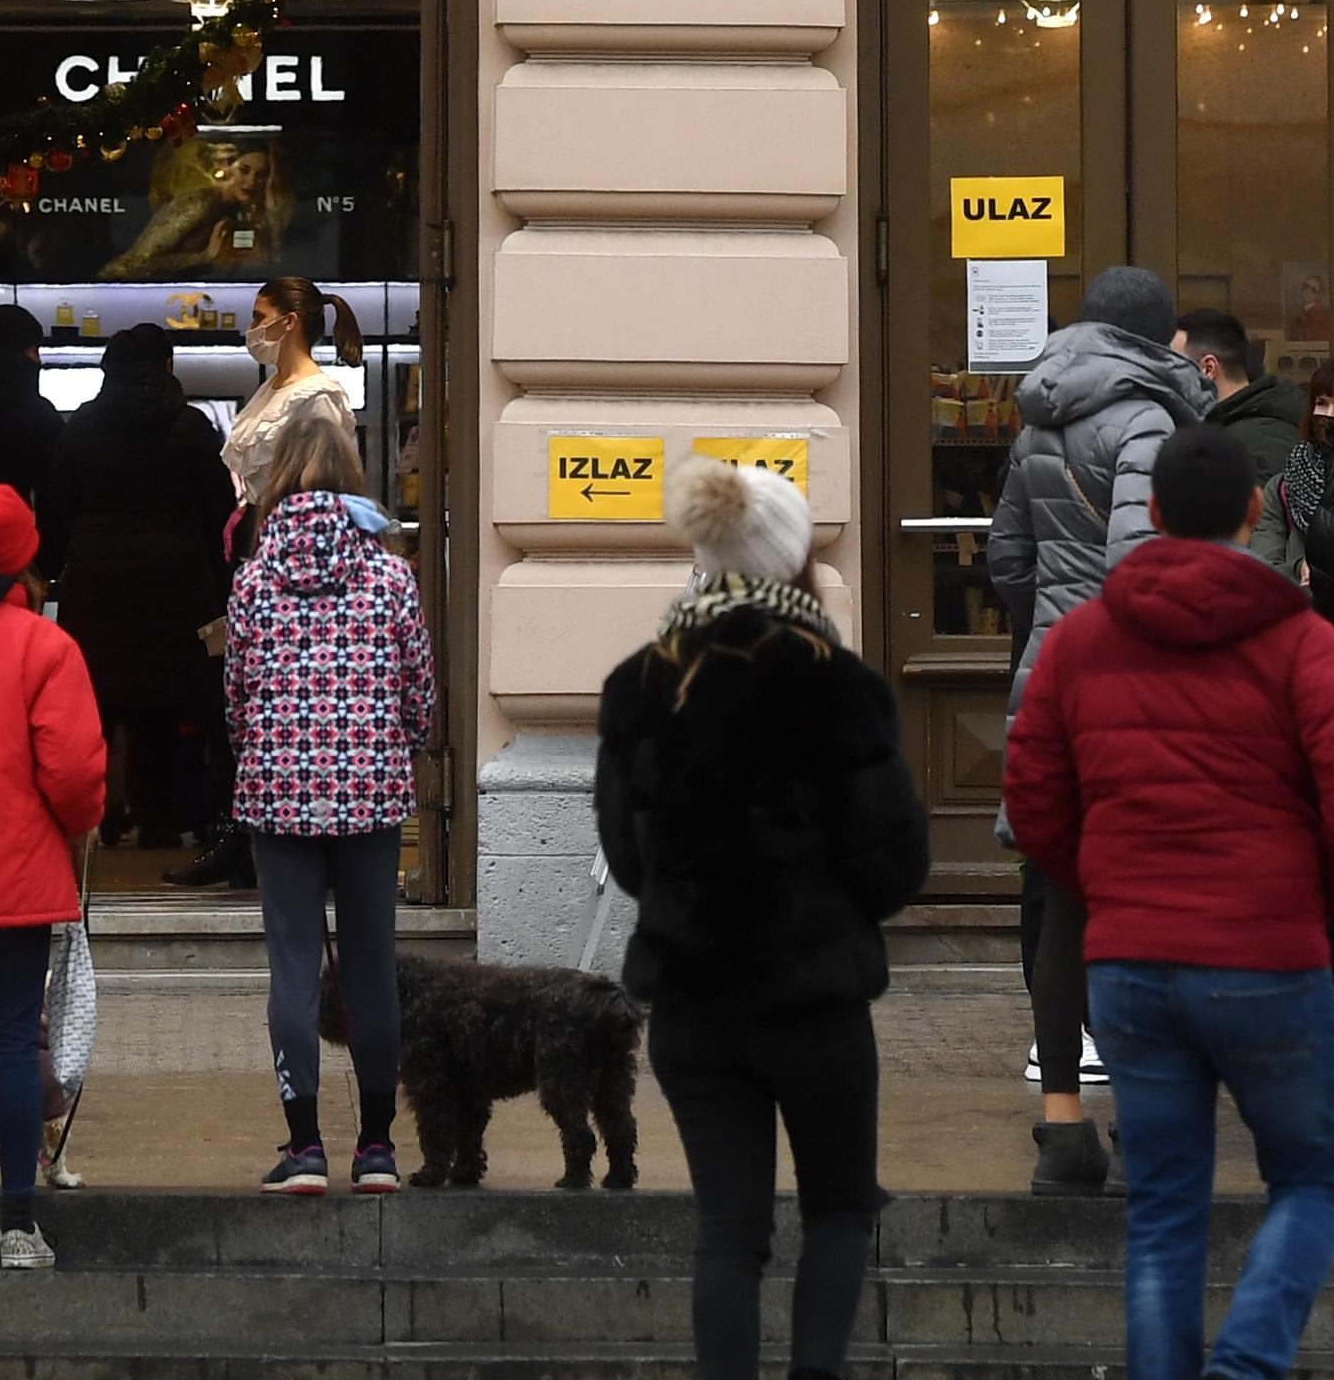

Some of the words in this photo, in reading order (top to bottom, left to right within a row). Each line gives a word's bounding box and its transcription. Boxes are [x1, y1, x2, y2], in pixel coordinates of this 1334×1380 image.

[38, 197, 126, 214] CHANEL
[963, 197, 1053, 221] ULAZ
[559, 457, 653, 479] IZLAZ
